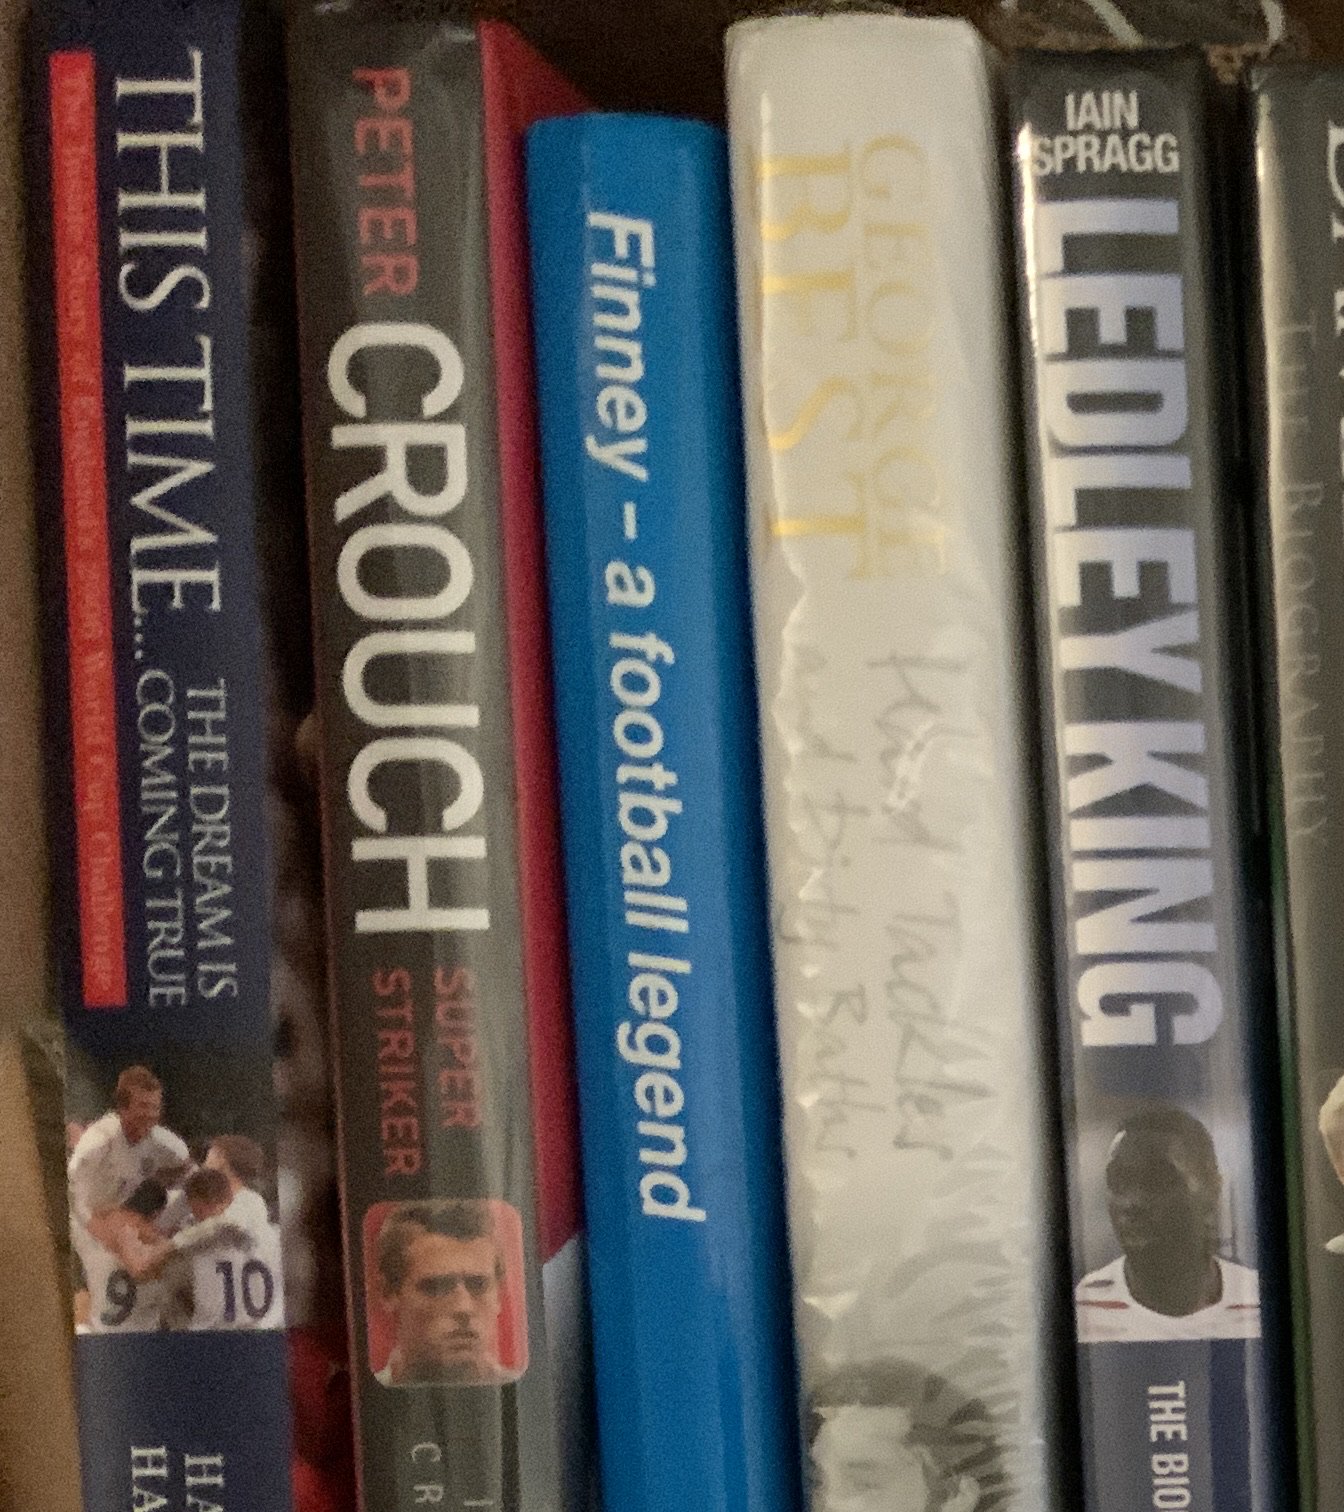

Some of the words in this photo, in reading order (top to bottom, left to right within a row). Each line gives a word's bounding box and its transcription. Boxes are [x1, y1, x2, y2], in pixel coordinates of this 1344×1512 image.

[115, 47, 211, 311] THIS
[353, 67, 420, 296] PETER
[1035, 133, 1180, 175] SPRAGG
[1066, 91, 1138, 130] IAIN
[586, 212, 654, 482] Finney
[1035, 200, 1201, 694] LEDLEY
[328, 322, 490, 933] CROUCH
[605, 561, 655, 607] a
[136, 669, 182, 879] COMING
[187, 678, 228, 772] THE
[610, 632, 689, 933] football
[145, 888, 186, 1006] TRUE
[190, 783, 233, 950] DREAM
[1064, 721, 1223, 1047] KING
[198, 961, 237, 999] IS
[434, 966, 481, 1128] SUPER
[372, 968, 421, 1176] STRIKER
[617, 952, 706, 1221] legend
[101, 1270, 136, 1326] 9
[216, 1260, 273, 1322] 10
[1148, 1381, 1187, 1442] THE
